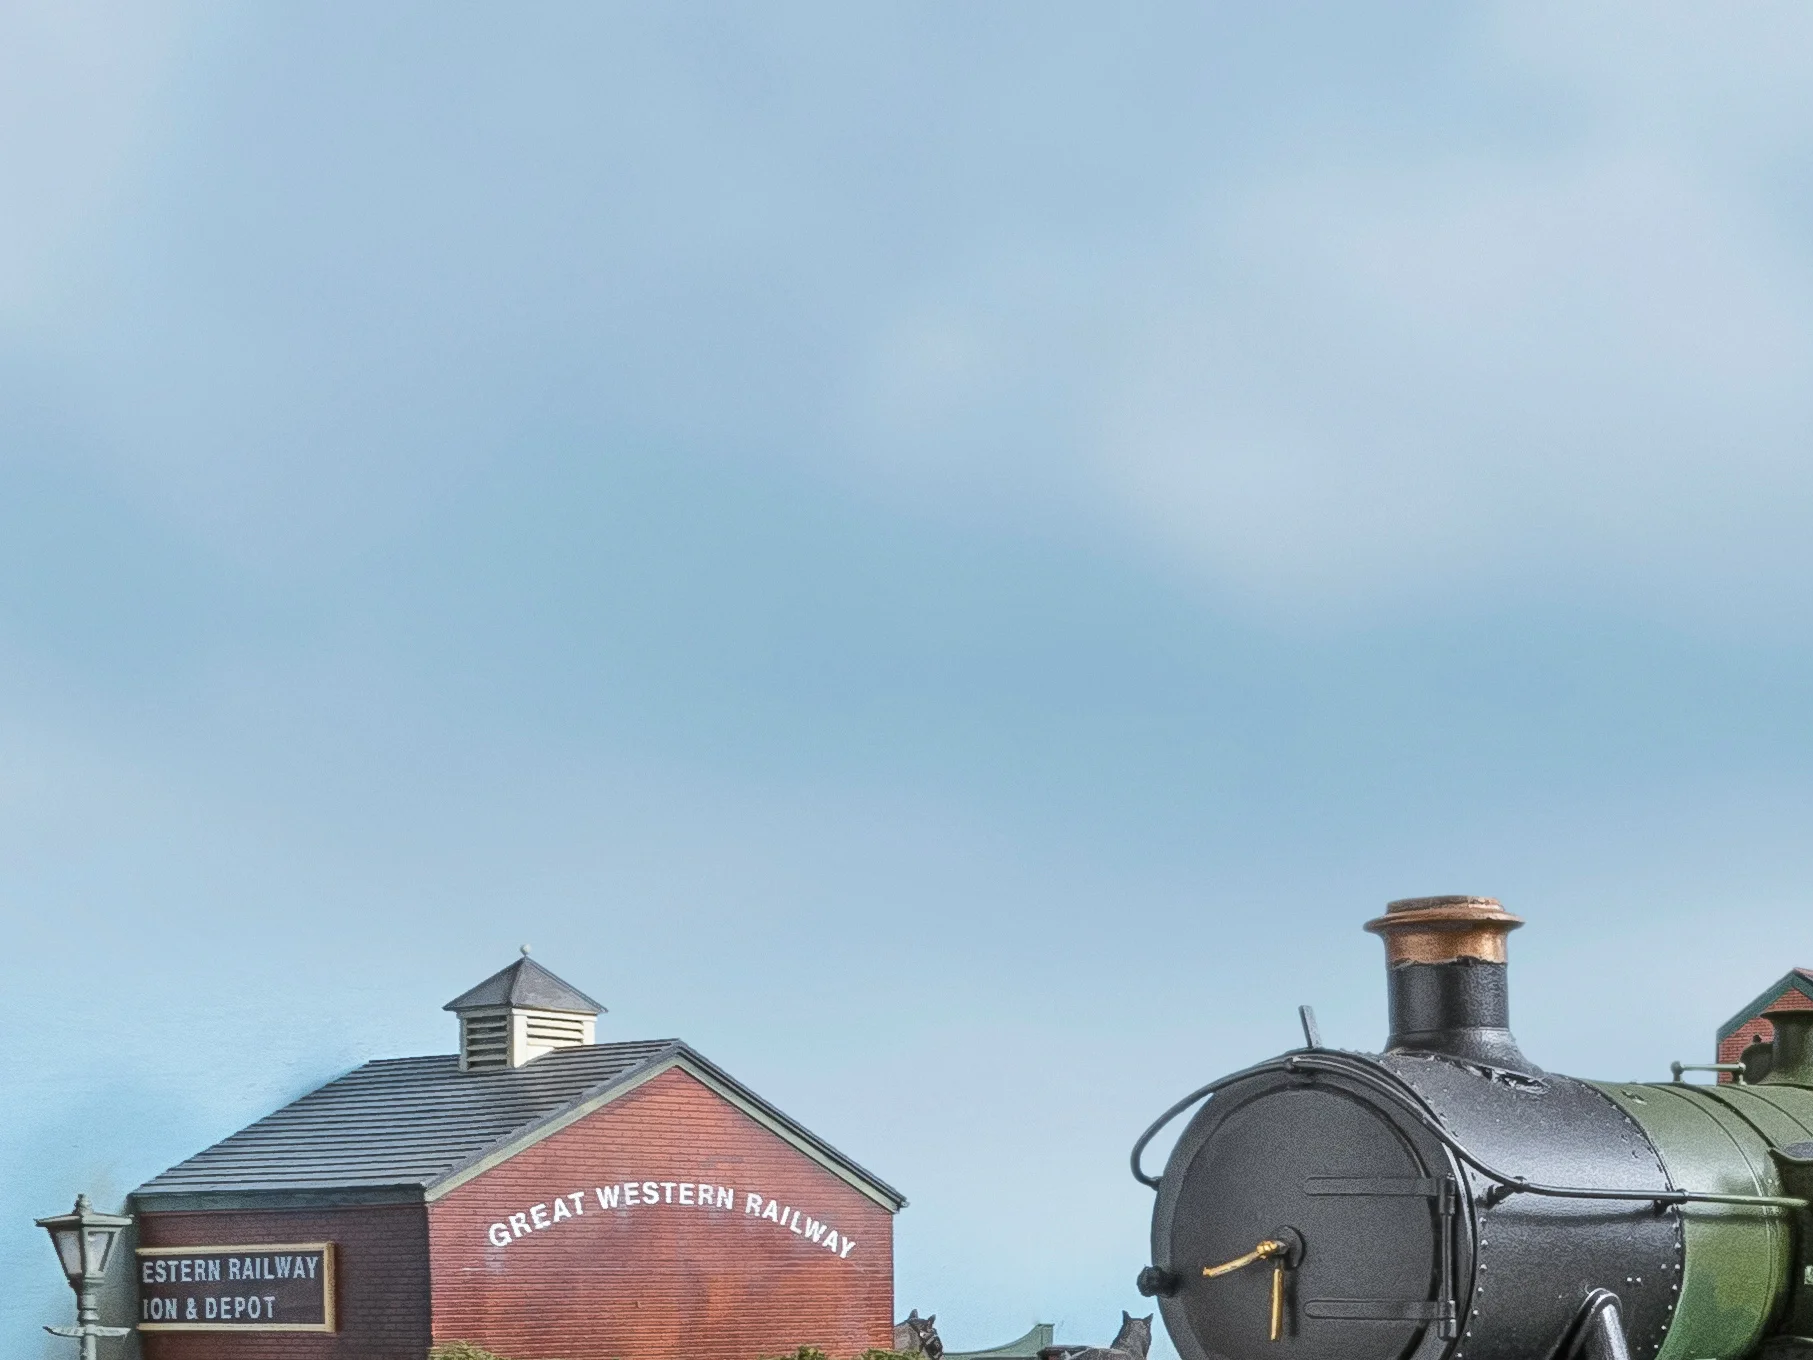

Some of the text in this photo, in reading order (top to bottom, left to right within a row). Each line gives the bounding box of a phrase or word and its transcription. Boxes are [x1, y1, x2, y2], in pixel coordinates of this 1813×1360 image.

[489, 1181, 857, 1260] GREAT WESTERN RAILWAY
[142, 1256, 319, 1283] ESTERN RAILWAY
[185, 1297, 199, 1319] &
[204, 1296, 276, 1319] DEPOT
